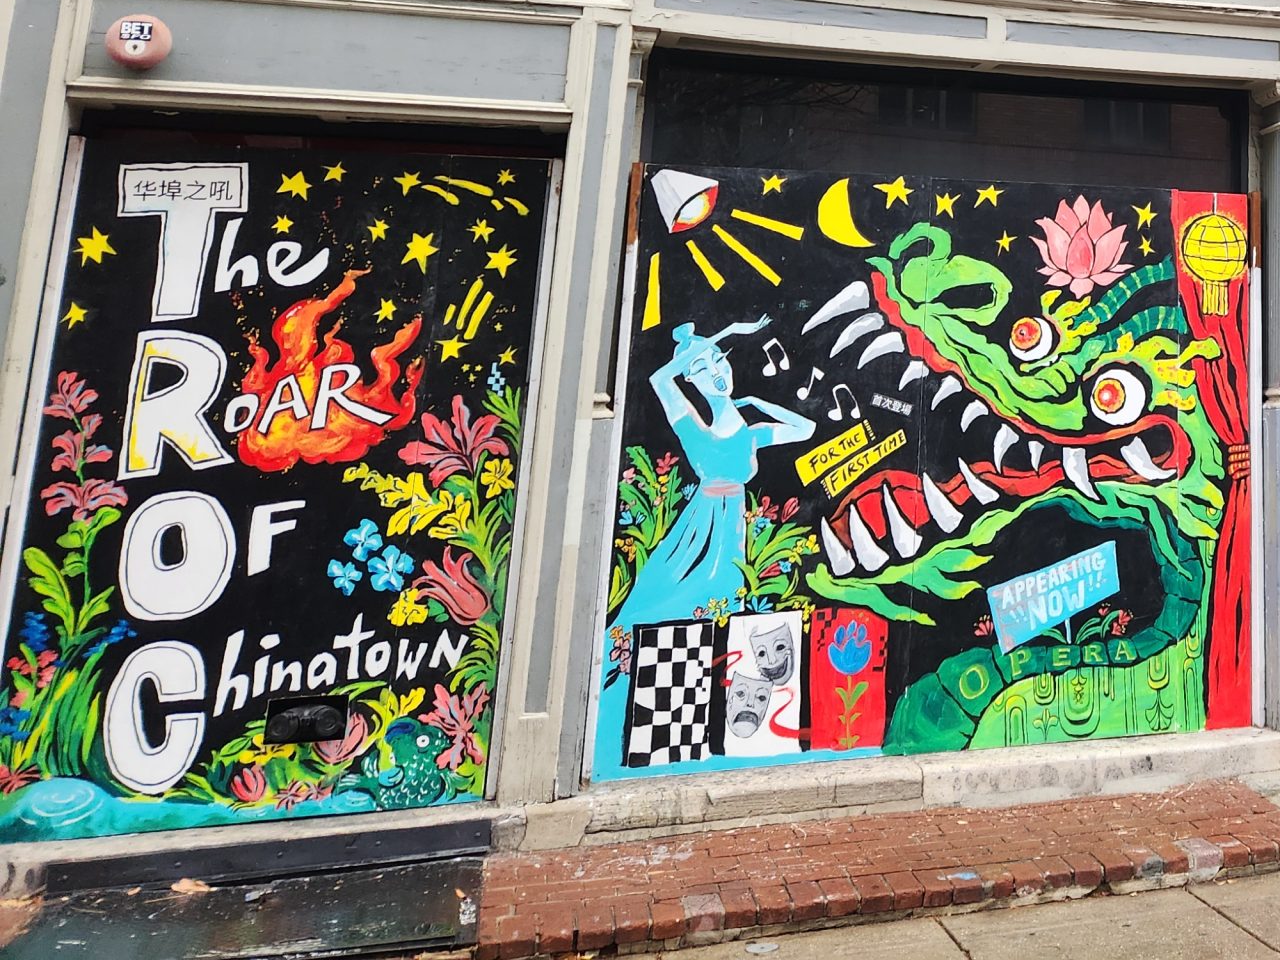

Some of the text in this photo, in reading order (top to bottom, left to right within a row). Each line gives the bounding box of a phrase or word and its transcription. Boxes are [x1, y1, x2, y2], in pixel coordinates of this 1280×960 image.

[120, 22, 153, 35] BET
[133, 179, 233, 202] 华埠之吼
[117, 162, 330, 323] The
[808, 432, 861, 474] FOR THE
[829, 432, 906, 492] FIRST TIME
[118, 491, 306, 622] OF
[1002, 551, 1106, 609] APPEARING
[958, 640, 1137, 700] OPERA
